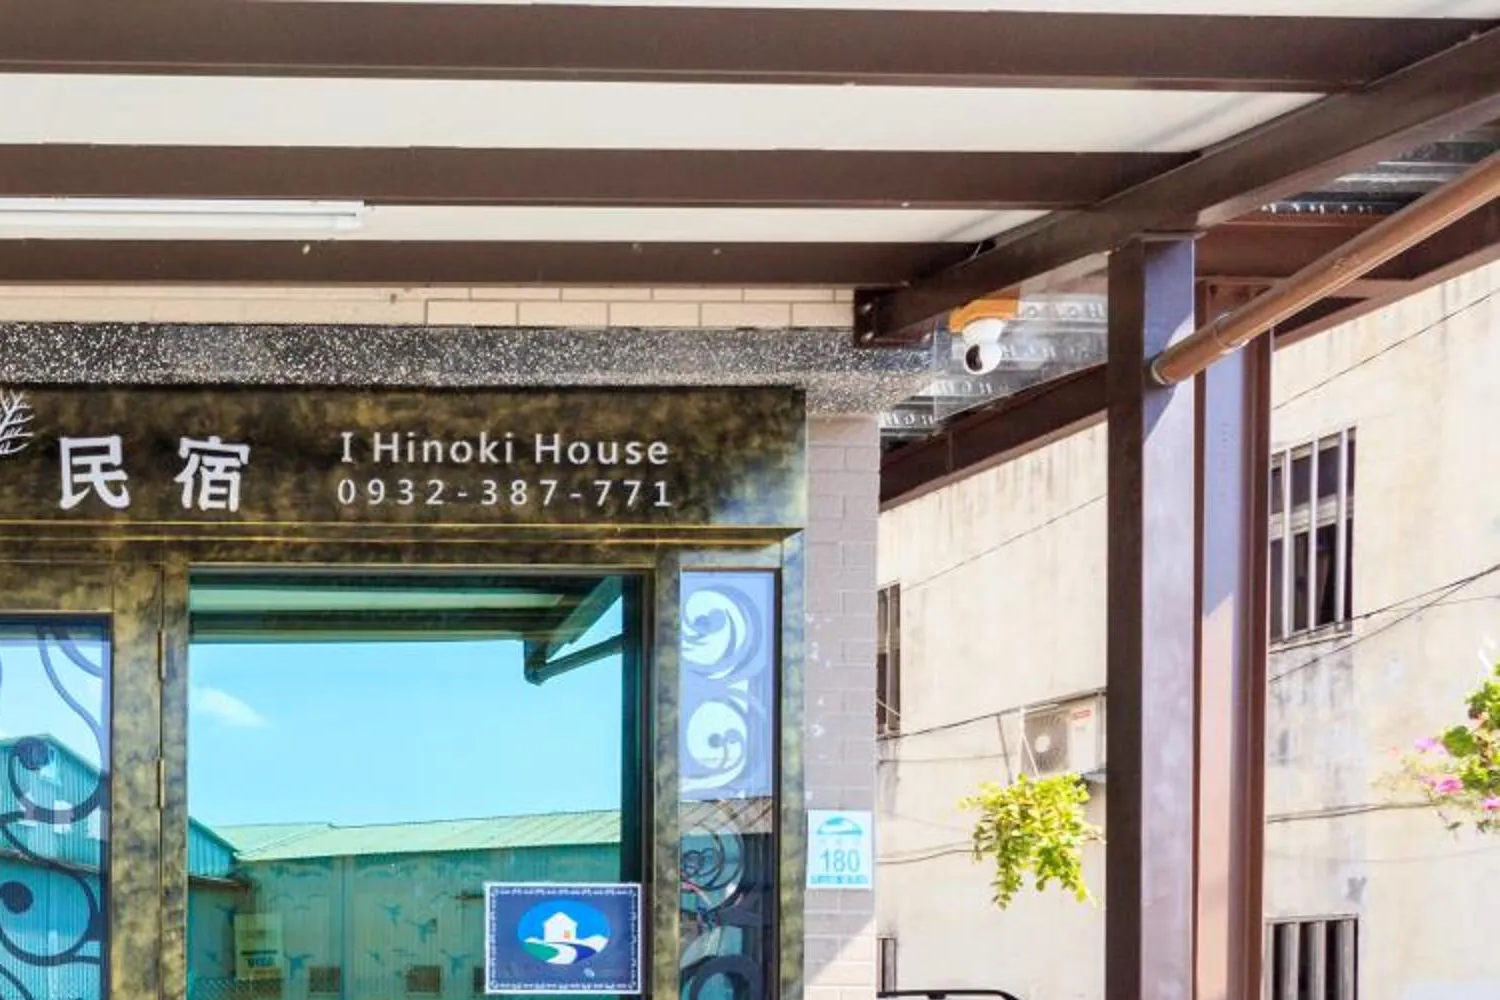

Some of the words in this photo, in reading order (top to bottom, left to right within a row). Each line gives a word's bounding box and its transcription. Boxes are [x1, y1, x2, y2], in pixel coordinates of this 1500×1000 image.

[340, 431, 354, 464] I
[372, 431, 514, 464] Hinoki
[534, 433, 669, 466] House
[336, 479, 672, 507] 0932-387-771
[820, 848, 861, 874] 180
